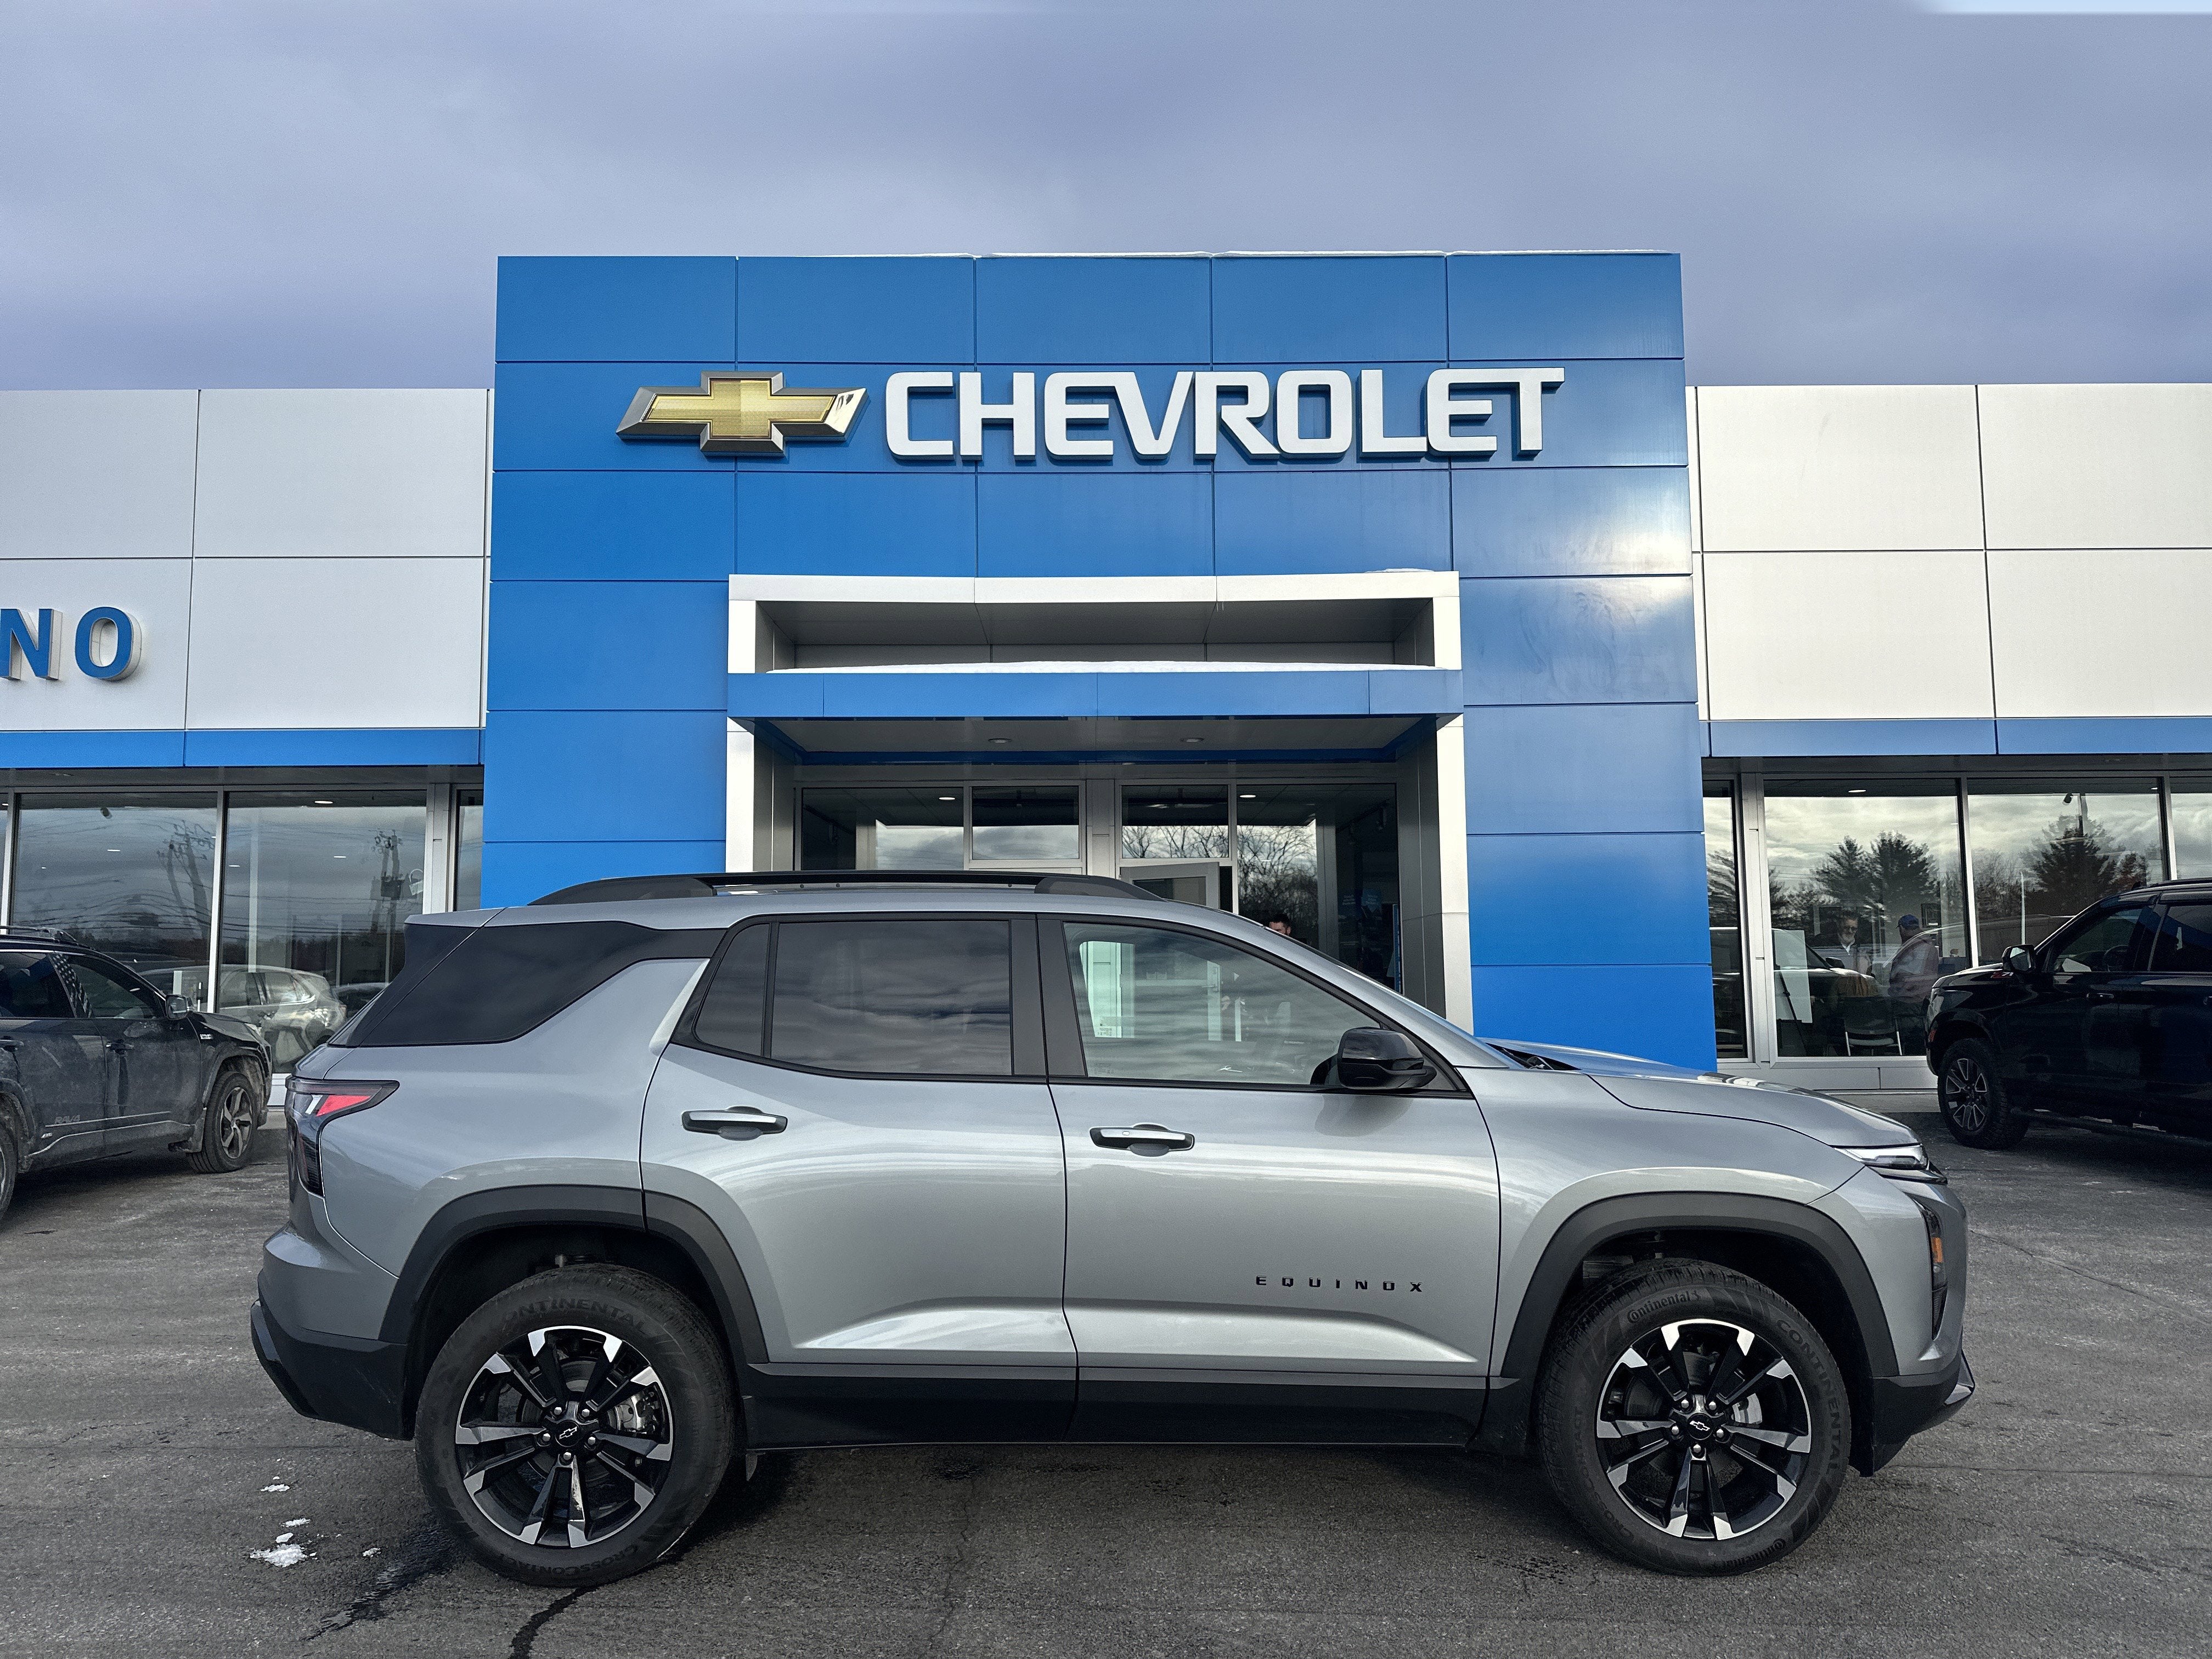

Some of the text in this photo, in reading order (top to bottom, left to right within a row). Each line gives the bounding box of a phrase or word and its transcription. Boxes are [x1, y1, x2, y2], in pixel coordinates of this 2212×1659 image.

[886, 366, 1565, 461] CHEVROLET
[0, 606, 142, 681] NO
[1256, 1276, 1423, 1292] EQUINOX
[1627, 1291, 1690, 1324] Continental
[1775, 1318, 1840, 1474] CONTINENTAL
